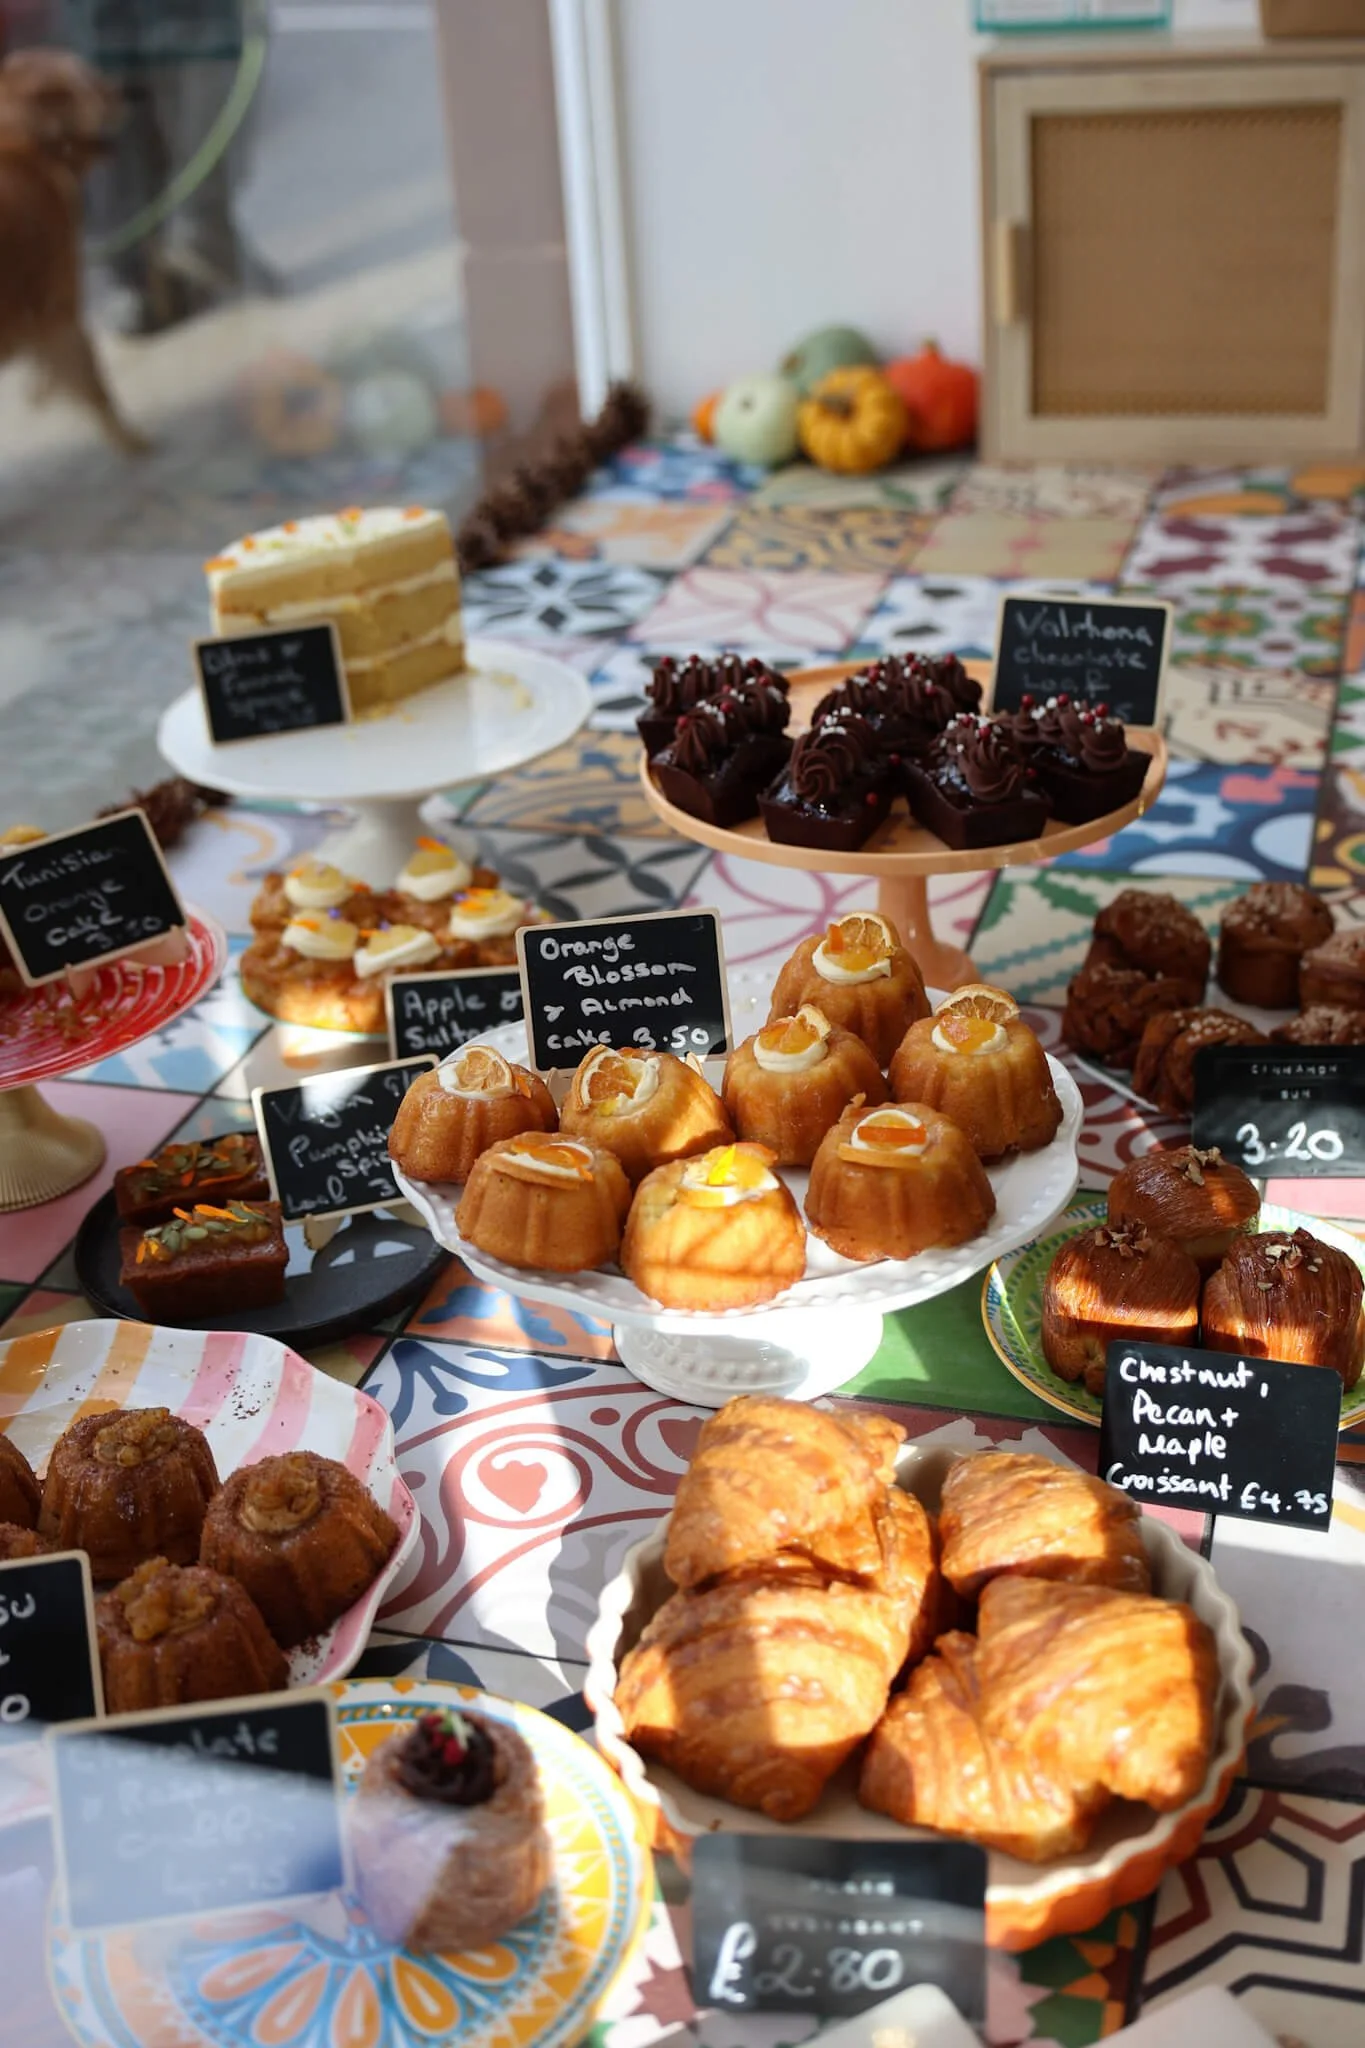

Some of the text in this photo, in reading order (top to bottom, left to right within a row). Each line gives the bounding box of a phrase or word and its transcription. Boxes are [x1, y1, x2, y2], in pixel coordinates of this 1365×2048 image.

[540, 933, 635, 962] Orange
[402, 984, 487, 1025] Apple
[580, 986, 694, 1017] Almond
[632, 1025, 710, 1050] 3.50
[289, 1125, 392, 1168] Pumpki
[1236, 1122, 1344, 1165] 3.20
[336, 1151, 391, 1178] Spic
[1119, 1356, 1269, 1398] Chestnut,
[1138, 1431, 1226, 1465] Maple
[1106, 1462, 1328, 1514] Croissant £4.75
